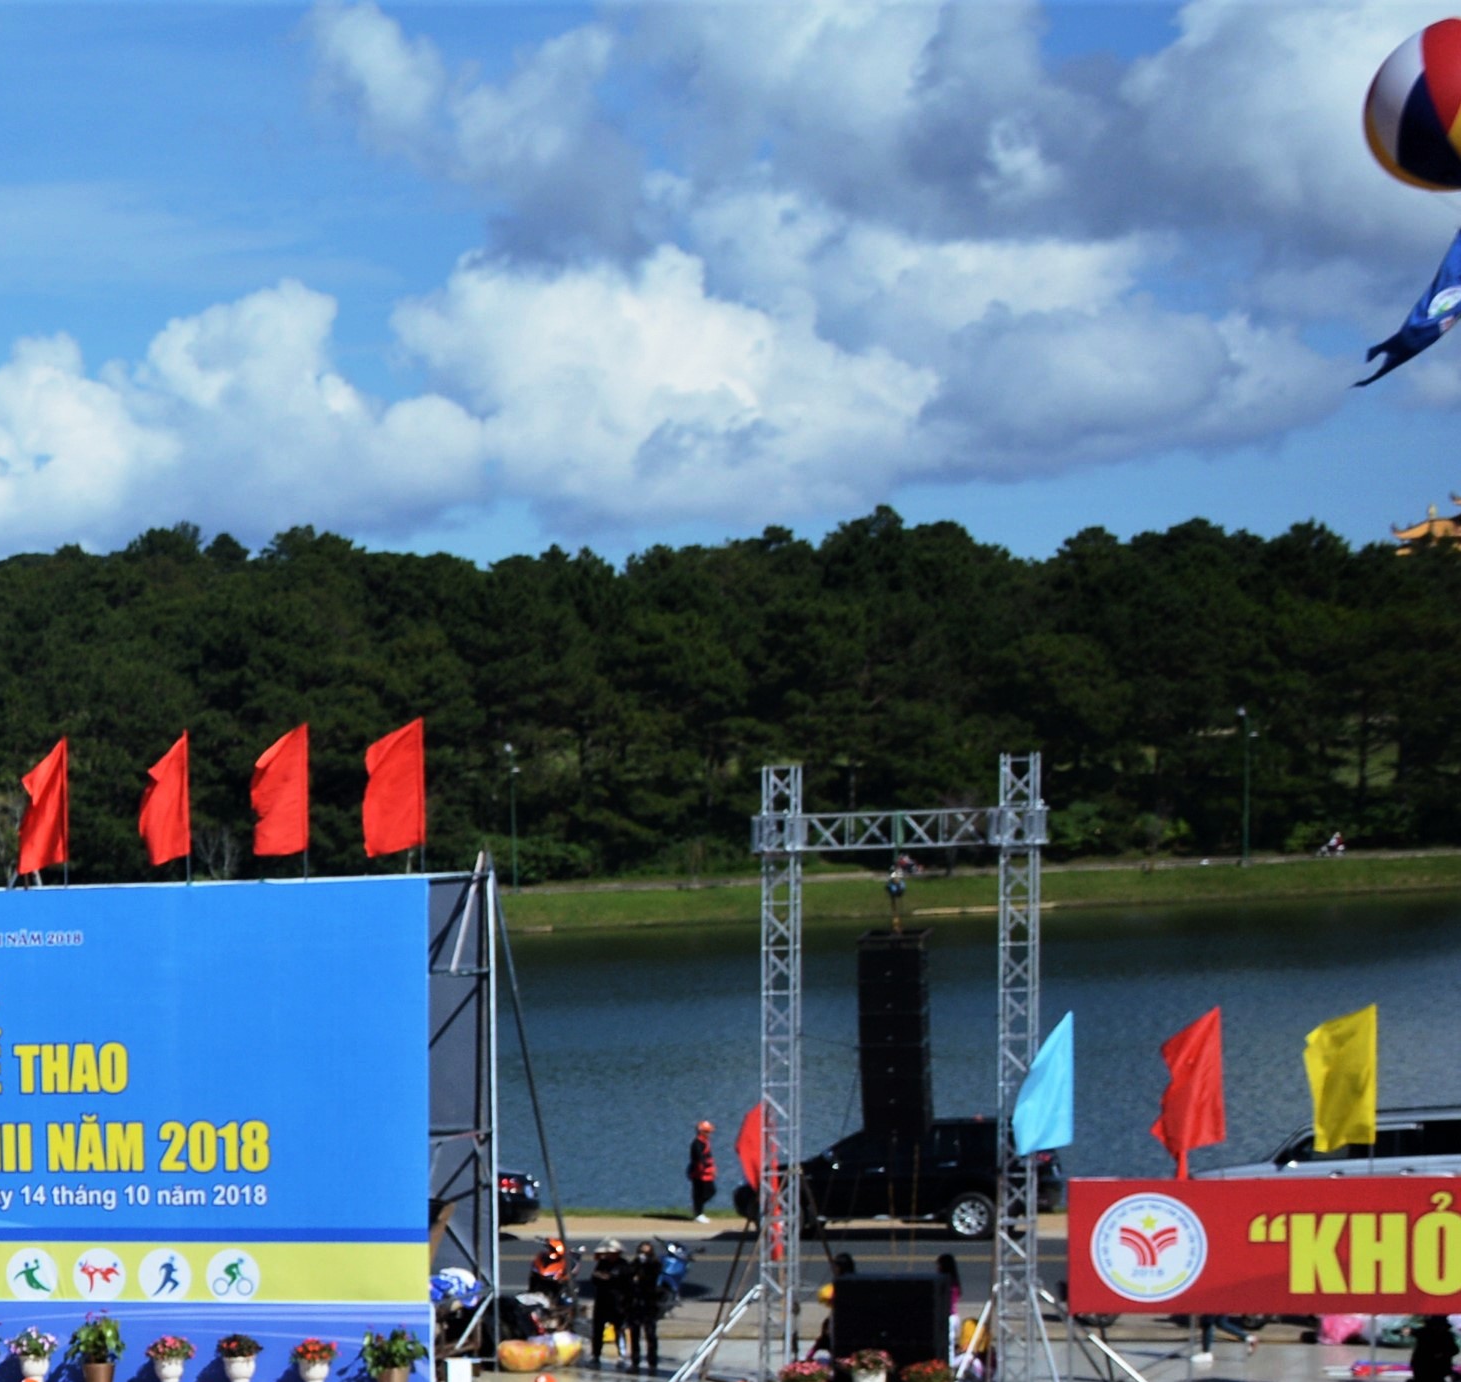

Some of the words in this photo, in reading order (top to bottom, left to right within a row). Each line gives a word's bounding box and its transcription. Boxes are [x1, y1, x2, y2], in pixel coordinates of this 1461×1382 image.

[6, 929, 43, 947] NĂM
[46, 931, 84, 946] 2018
[12, 1041, 129, 1095] THAO
[46, 1113, 145, 1173] NĂM
[158, 1119, 271, 1173] 2018
[19, 1185, 47, 1206] 14
[51, 1184, 118, 1211] tháng
[123, 1185, 151, 1206] 10
[156, 1185, 207, 1206] năm
[212, 1184, 268, 1206] 2018
